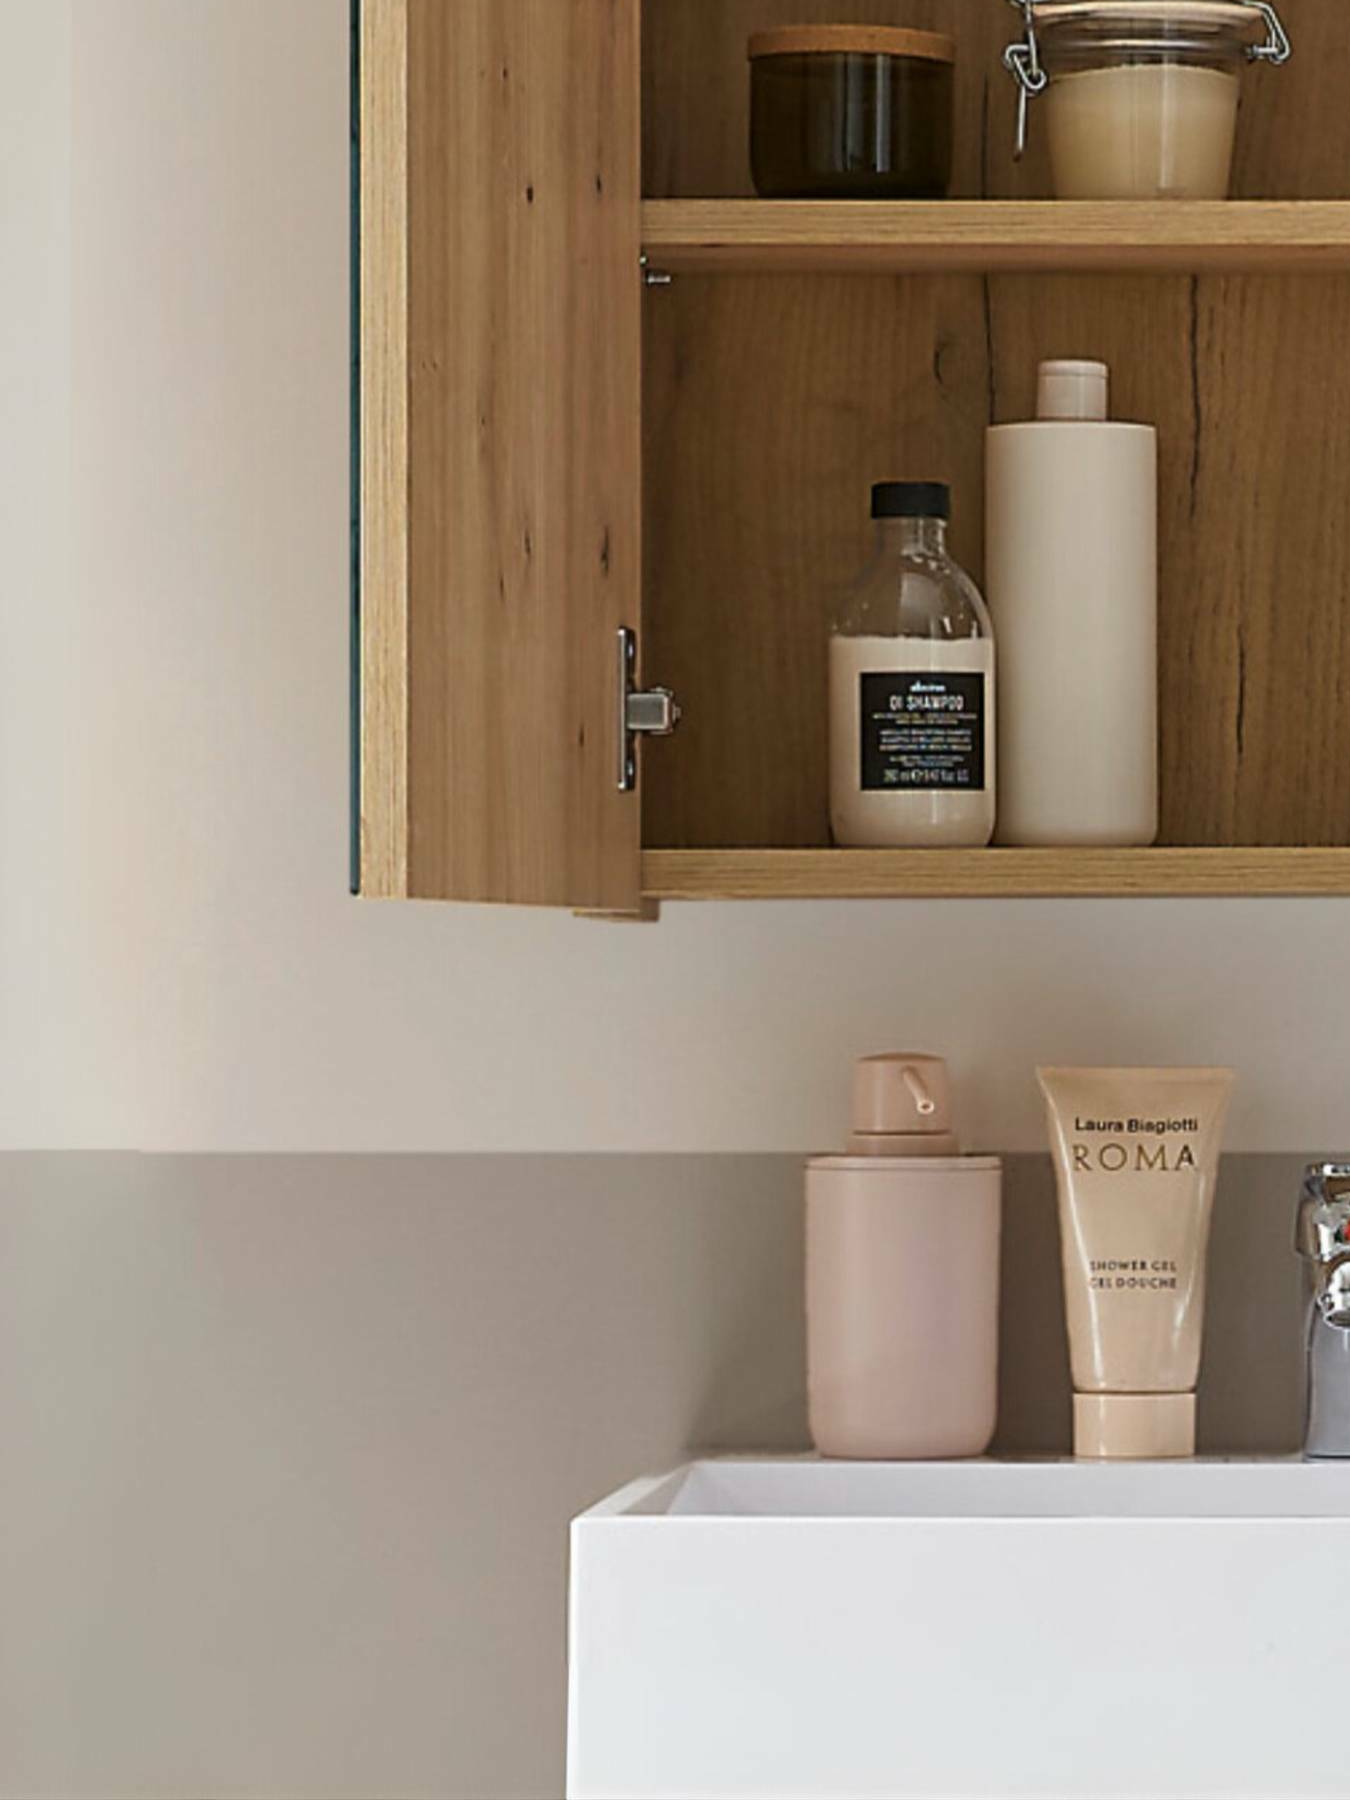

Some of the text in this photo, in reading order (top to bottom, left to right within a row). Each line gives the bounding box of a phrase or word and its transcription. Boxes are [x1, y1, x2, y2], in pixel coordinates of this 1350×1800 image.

[906, 695, 965, 711] SHAMPOO
[1075, 1117, 1198, 1135] Laura Biagiotti
[1072, 1143, 1199, 1172] ROMA
[1090, 1260, 1147, 1272] SHOWER
